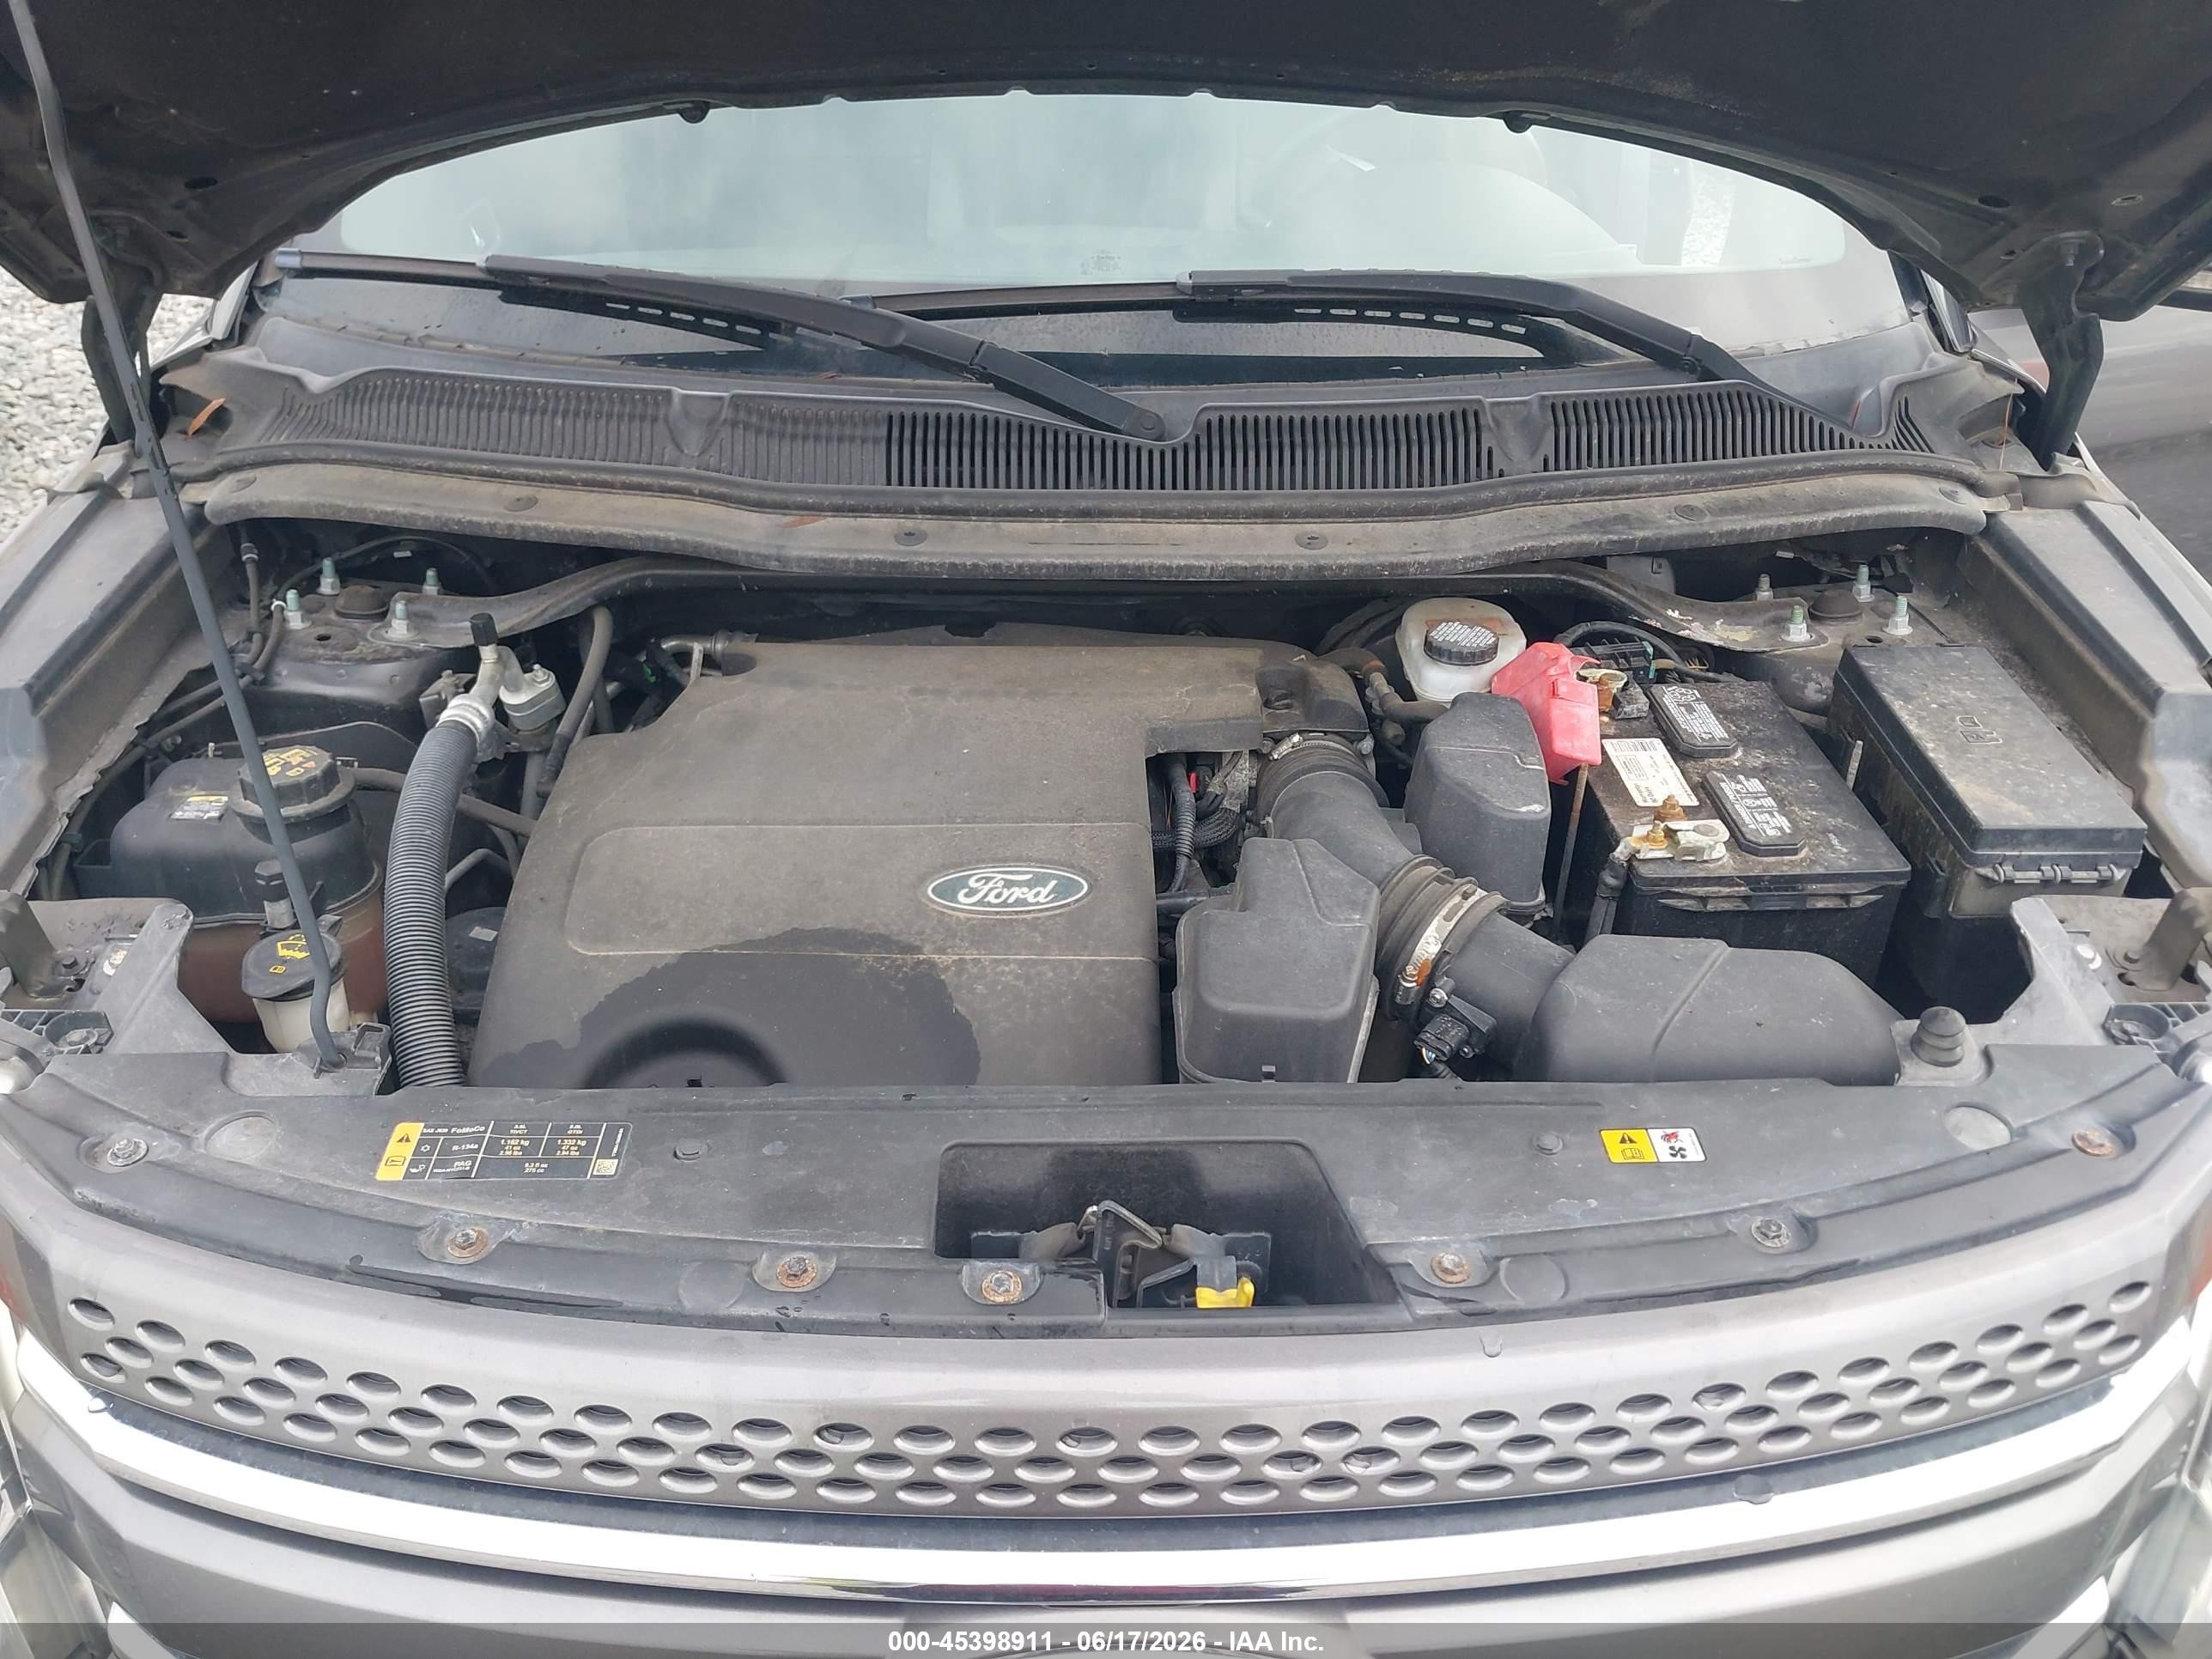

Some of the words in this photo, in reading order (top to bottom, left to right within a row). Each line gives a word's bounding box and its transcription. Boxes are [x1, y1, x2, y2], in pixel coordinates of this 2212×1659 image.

[1719, 782, 1736, 800] POISON
[1734, 804, 1753, 824] DANGER
[957, 872, 1058, 904] Ford
[451, 1125, 486, 1134] FoMoCo
[452, 1143, 479, 1152] R-134a
